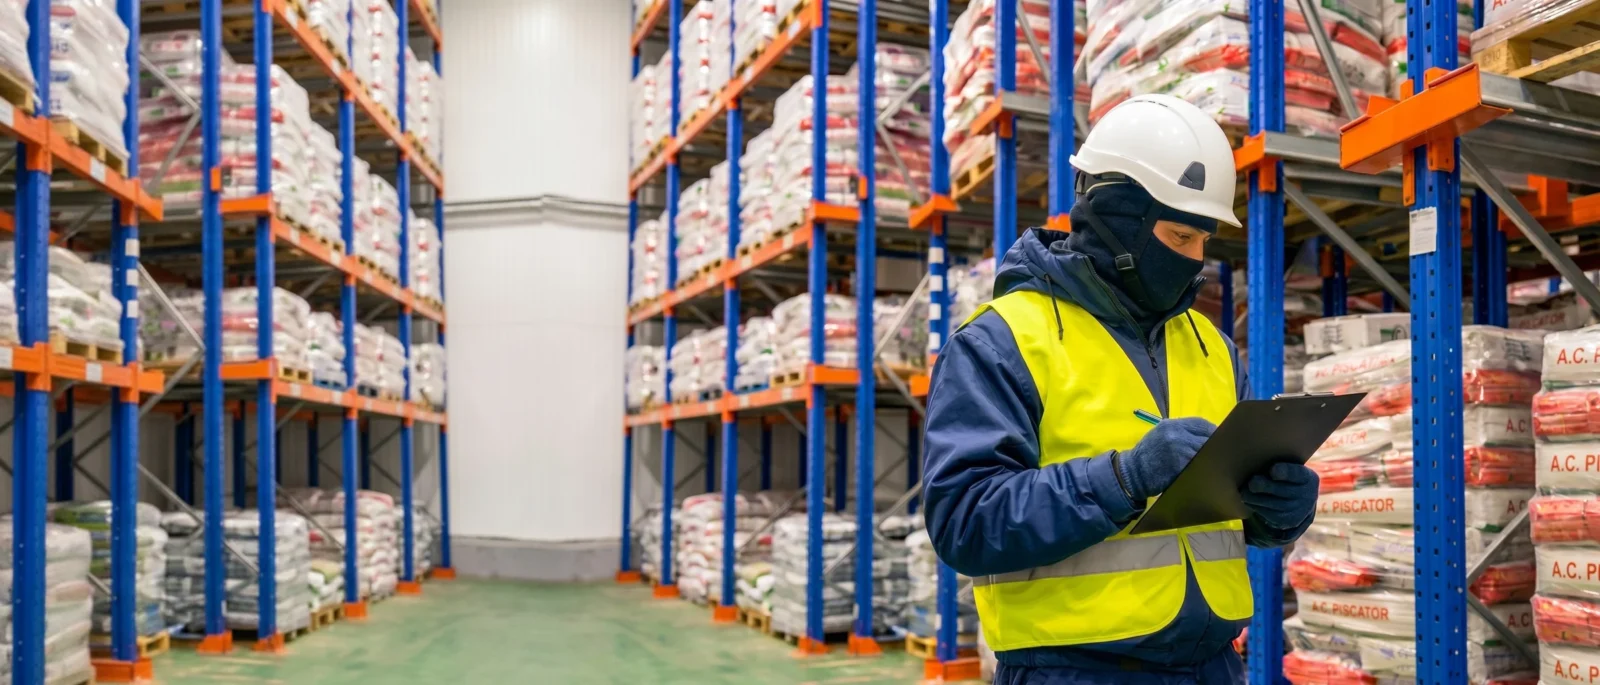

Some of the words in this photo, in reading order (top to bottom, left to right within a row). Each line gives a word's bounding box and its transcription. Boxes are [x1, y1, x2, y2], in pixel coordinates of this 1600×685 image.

[1557, 347, 1588, 365] A.C.
[1550, 455, 1580, 473] A.C.
[1332, 498, 1394, 513] PISCATOR
[1552, 561, 1582, 580] A.C.
[1332, 603, 1389, 620] PISCATOR
[1554, 660, 1584, 682] A.C.
